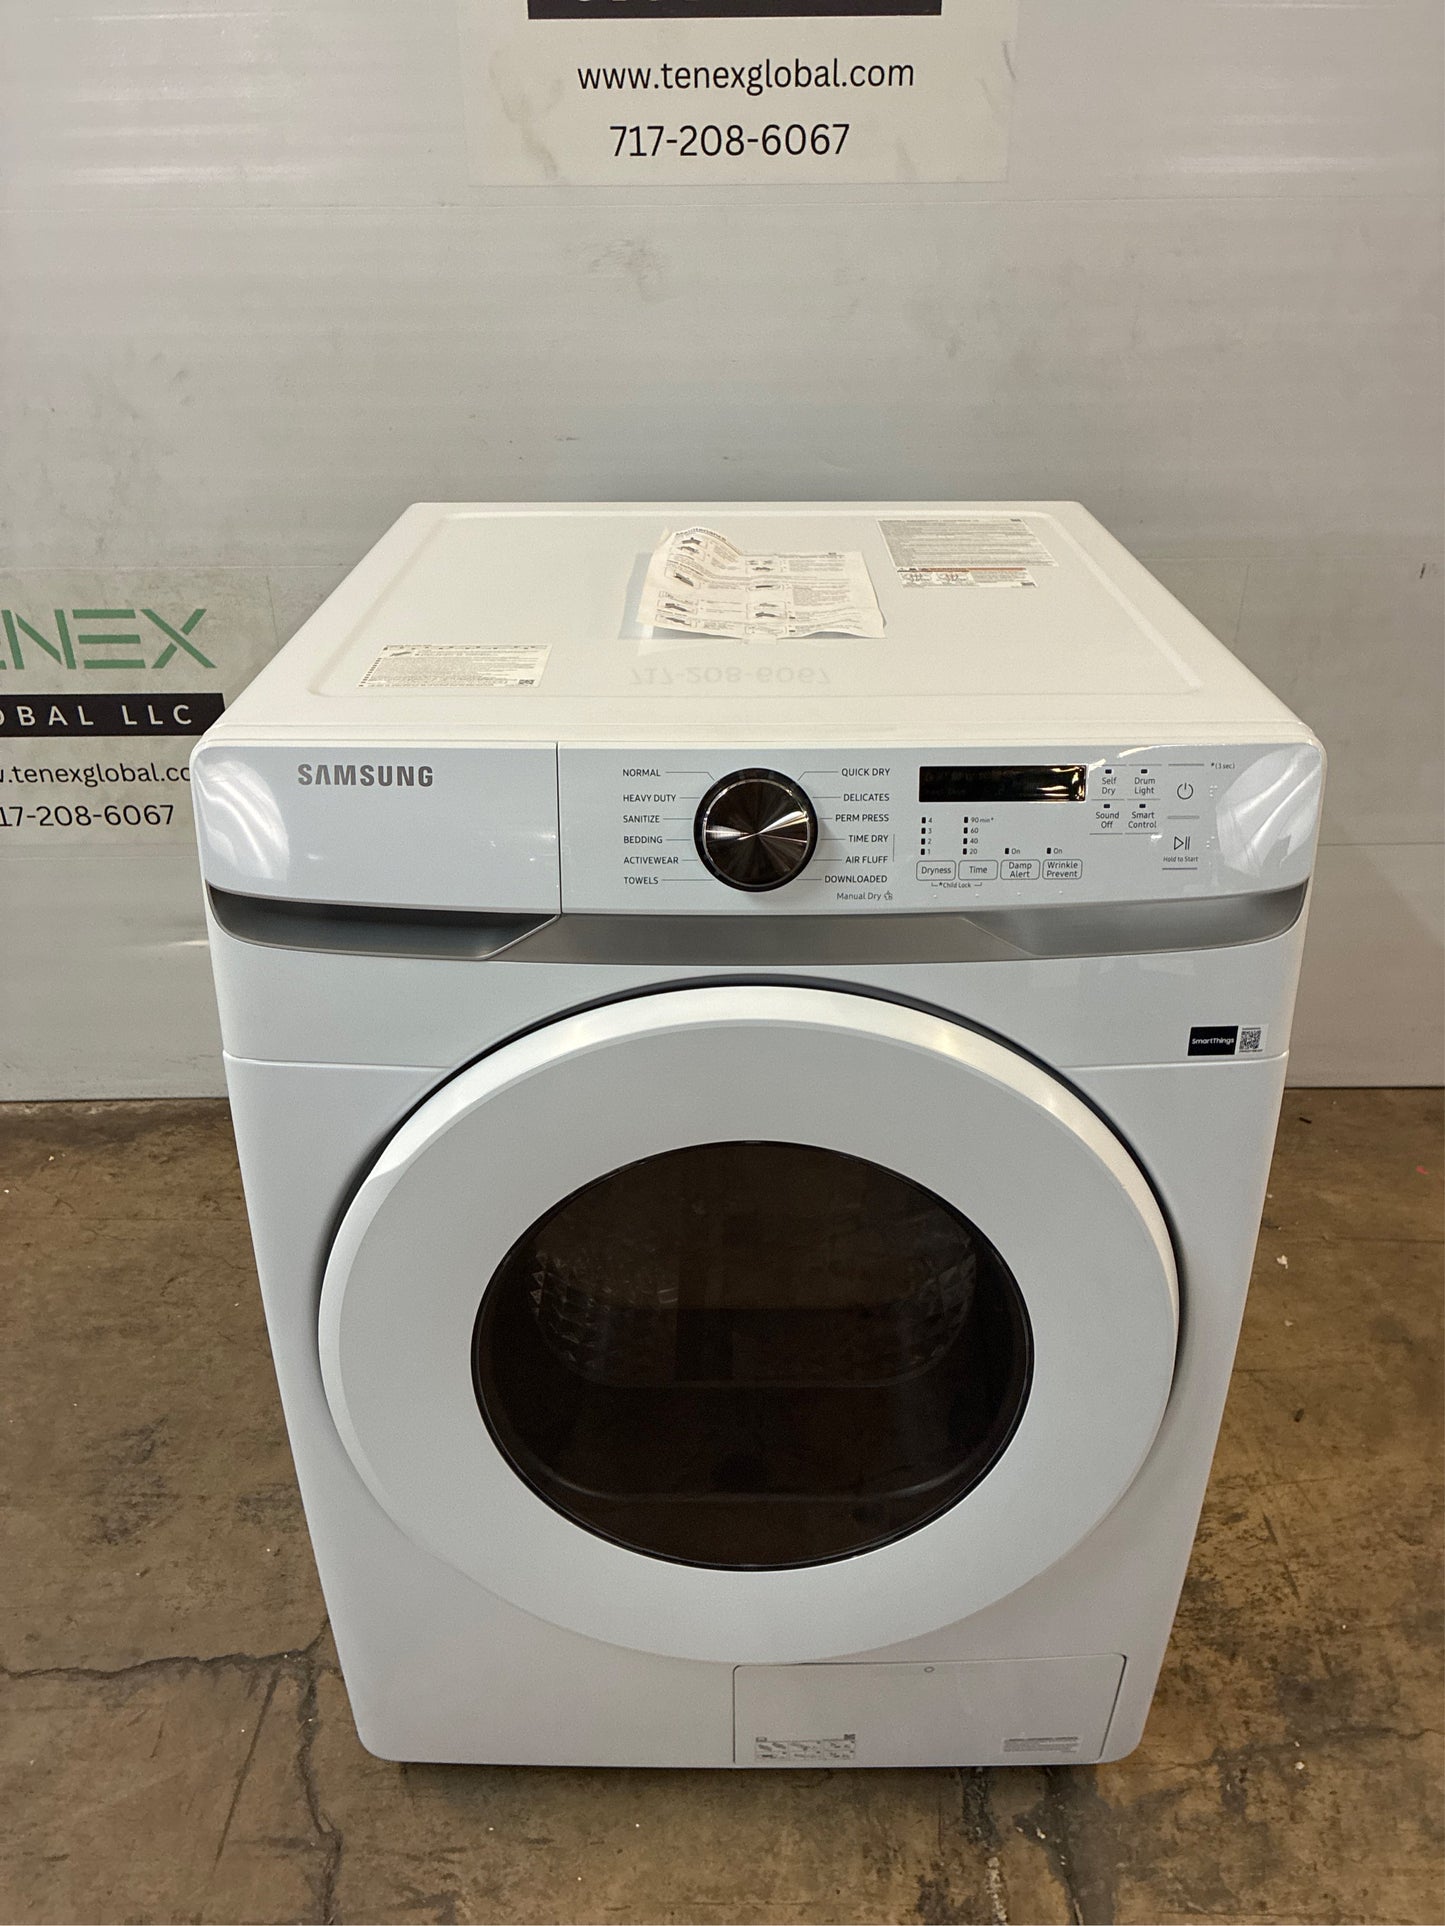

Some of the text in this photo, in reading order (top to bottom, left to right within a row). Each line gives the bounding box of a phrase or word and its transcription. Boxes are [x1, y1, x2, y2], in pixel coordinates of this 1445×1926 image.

[578, 58, 913, 96] www.tenexglobal.com
[610, 124, 849, 156] 717-208-6067
[0, 608, 217, 670] NEX
[122, 705, 191, 724] LLC
[0, 763, 188, 787] .tenexglobal.co
[298, 764, 432, 787] SAMSUNG
[622, 768, 661, 777] NORMAL
[841, 767, 891, 777] QUICK DRY
[1101, 776, 1117, 785] Self
[1134, 776, 1156, 785] Drum
[1101, 786, 1116, 796] Dry
[1134, 786, 1155, 796] Light
[622, 794, 677, 803] HEAVY DUTY
[843, 793, 890, 802] DELICATES
[622, 814, 660, 824] SANITIZE
[835, 813, 890, 823] PERM PRESS
[1095, 811, 1120, 820] Sound
[1131, 810, 1155, 819] Smart
[970, 816, 980, 824] 90
[1100, 820, 1114, 829] Off
[1127, 820, 1157, 829] Control
[927, 827, 933, 835] 3
[623, 835, 663, 844] BEDDING
[848, 834, 889, 843] TIME DRY
[927, 837, 932, 845] 2
[969, 837, 979, 845] 40
[969, 847, 978, 855] 20
[1011, 847, 1021, 855] On
[1053, 847, 1063, 855] On
[623, 856, 679, 865] ACTIVEWEAR
[845, 855, 889, 864] AIR FLUFF
[1184, 855, 1199, 863] Start
[969, 865, 988, 874] Time
[1008, 861, 1033, 871] Damp
[1047, 861, 1079, 869] Wrinkle
[921, 866, 952, 876] Dryness
[1009, 870, 1031, 879] Alert
[1046, 870, 1079, 879] Prevent
[623, 876, 659, 885] TOWELS
[824, 874, 888, 884] DOWNLOADED
[836, 892, 882, 901] Manual Dry
[1191, 1037, 1235, 1046] SmartThings
